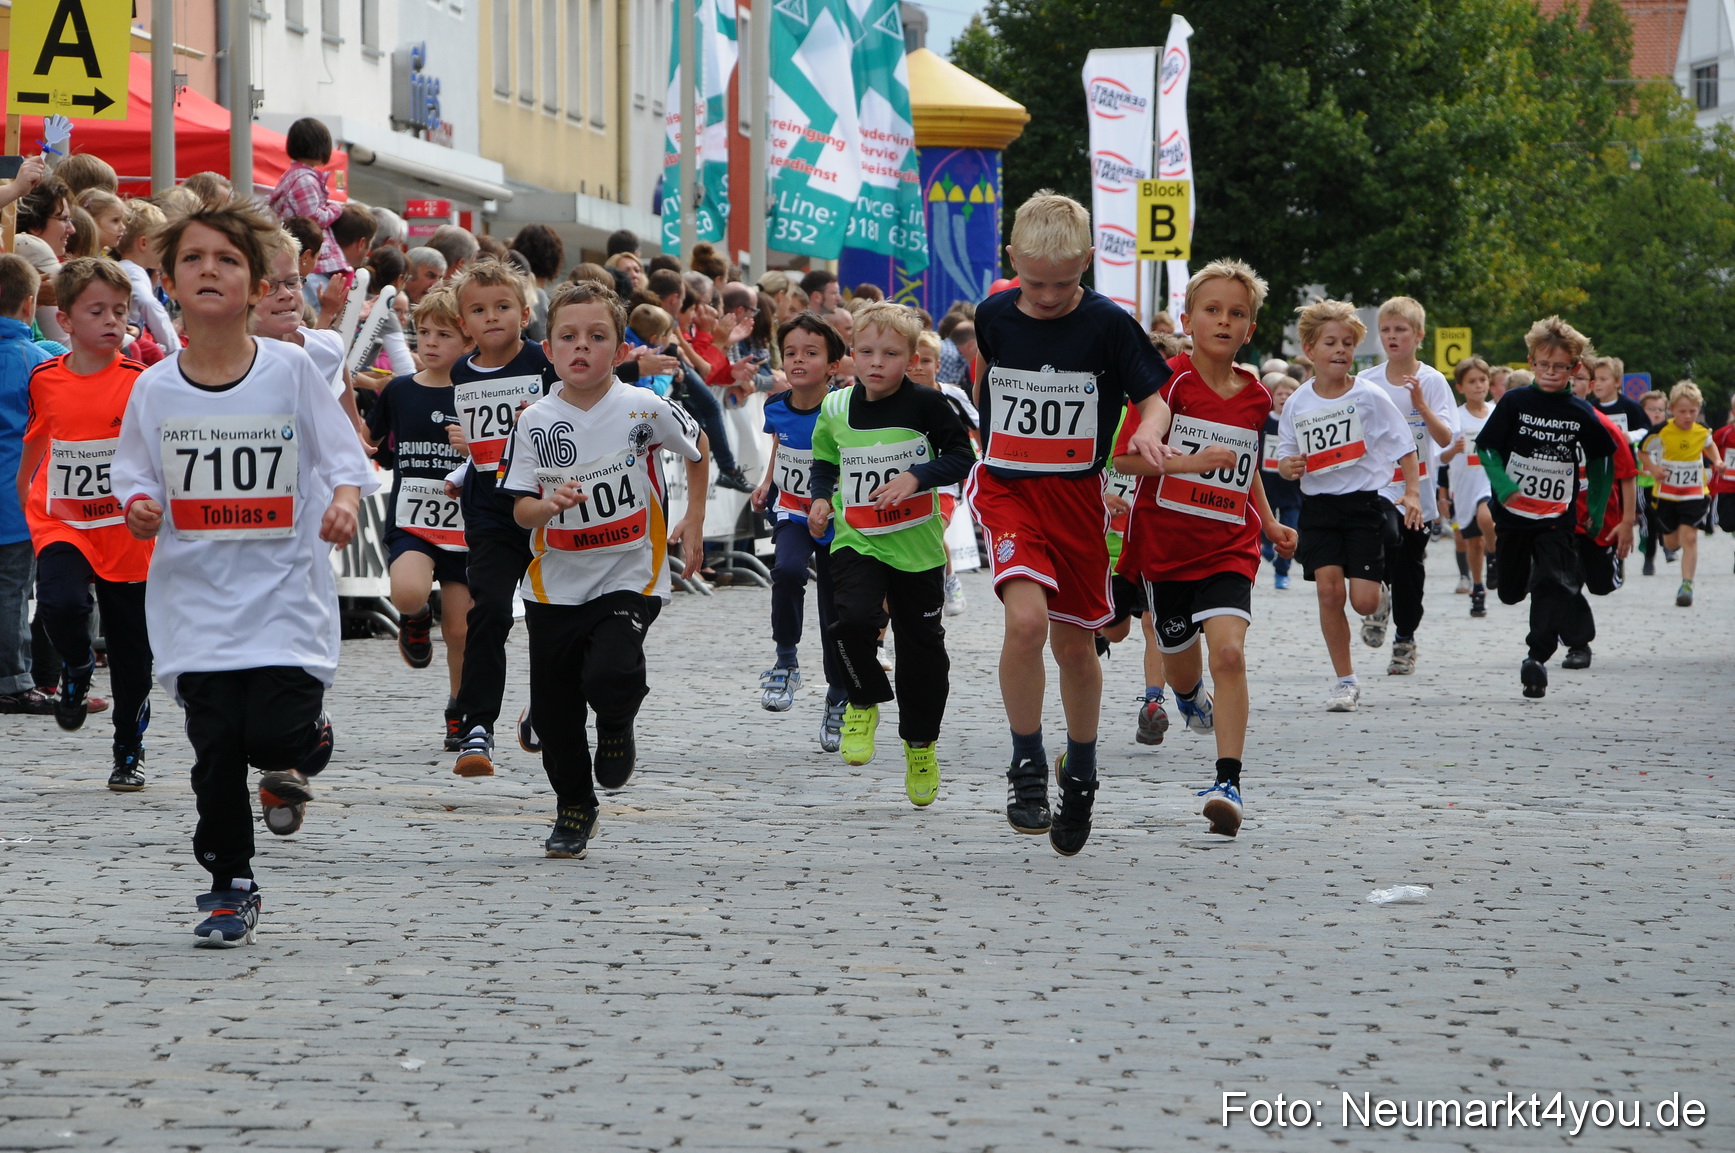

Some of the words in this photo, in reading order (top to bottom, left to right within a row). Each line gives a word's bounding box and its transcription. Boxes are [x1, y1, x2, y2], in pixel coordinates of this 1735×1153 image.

[33, 0, 102, 78] A
[1143, 182, 1184, 197] Block
[1151, 204, 1176, 242] B
[1445, 344, 1462, 367] C
[456, 391, 480, 402] PARTL
[481, 386, 525, 399] Neumarkt
[991, 378, 1024, 390] PARTL
[1026, 382, 1079, 393] Neumarkt
[1002, 395, 1085, 436] 7307
[1312, 409, 1345, 424] Neumarkt
[163, 429, 207, 441] PARTL
[210, 428, 276, 441] Neumarkt
[530, 421, 577, 468] 16
[1174, 424, 1209, 440] PARTL
[1211, 432, 1252, 450] Neumarkt
[1303, 419, 1351, 454] 7327
[78, 448, 116, 459] Neumar
[842, 457, 866, 465] PARTL
[867, 450, 913, 465] Neumarkt
[176, 446, 283, 491] 7107
[570, 462, 623, 483] Neumarkt
[1510, 458, 1531, 471] PARTL
[1532, 465, 1564, 475] Neumarkt
[1667, 469, 1698, 485] 7124
[56, 463, 112, 496] 725
[401, 485, 430, 495] PARTL
[1513, 471, 1565, 501] 7396
[1190, 487, 1230, 509] Lukas
[82, 503, 114, 517] Nico
[201, 504, 263, 525] Tobias
[407, 498, 460, 528] 732
[875, 509, 901, 524] Tim
[573, 526, 630, 547] Marius
[1165, 622, 1185, 635] FCN
